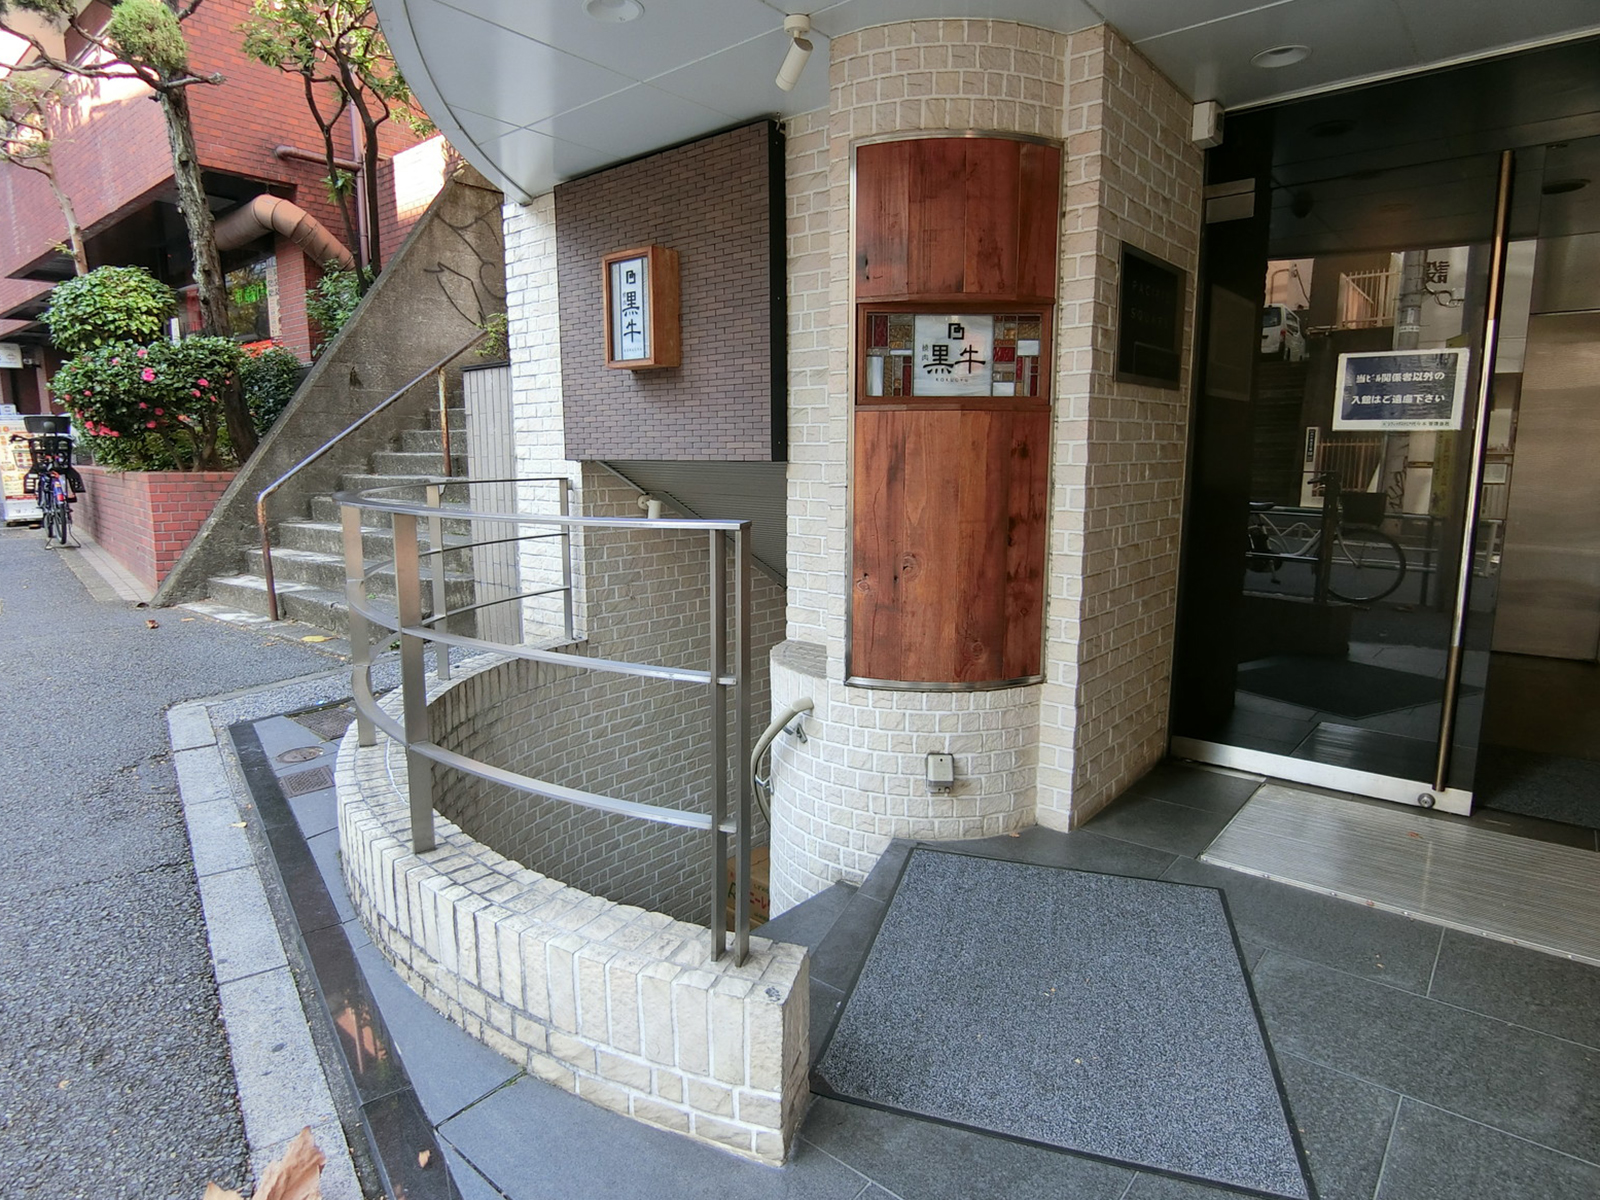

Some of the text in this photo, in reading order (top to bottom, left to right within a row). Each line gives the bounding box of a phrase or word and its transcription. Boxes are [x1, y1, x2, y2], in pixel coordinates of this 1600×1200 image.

[622, 291, 642, 343] 黒牛
[923, 344, 986, 374] 黒牛
[1351, 394, 1446, 405] 入館はご遠慮下さい
